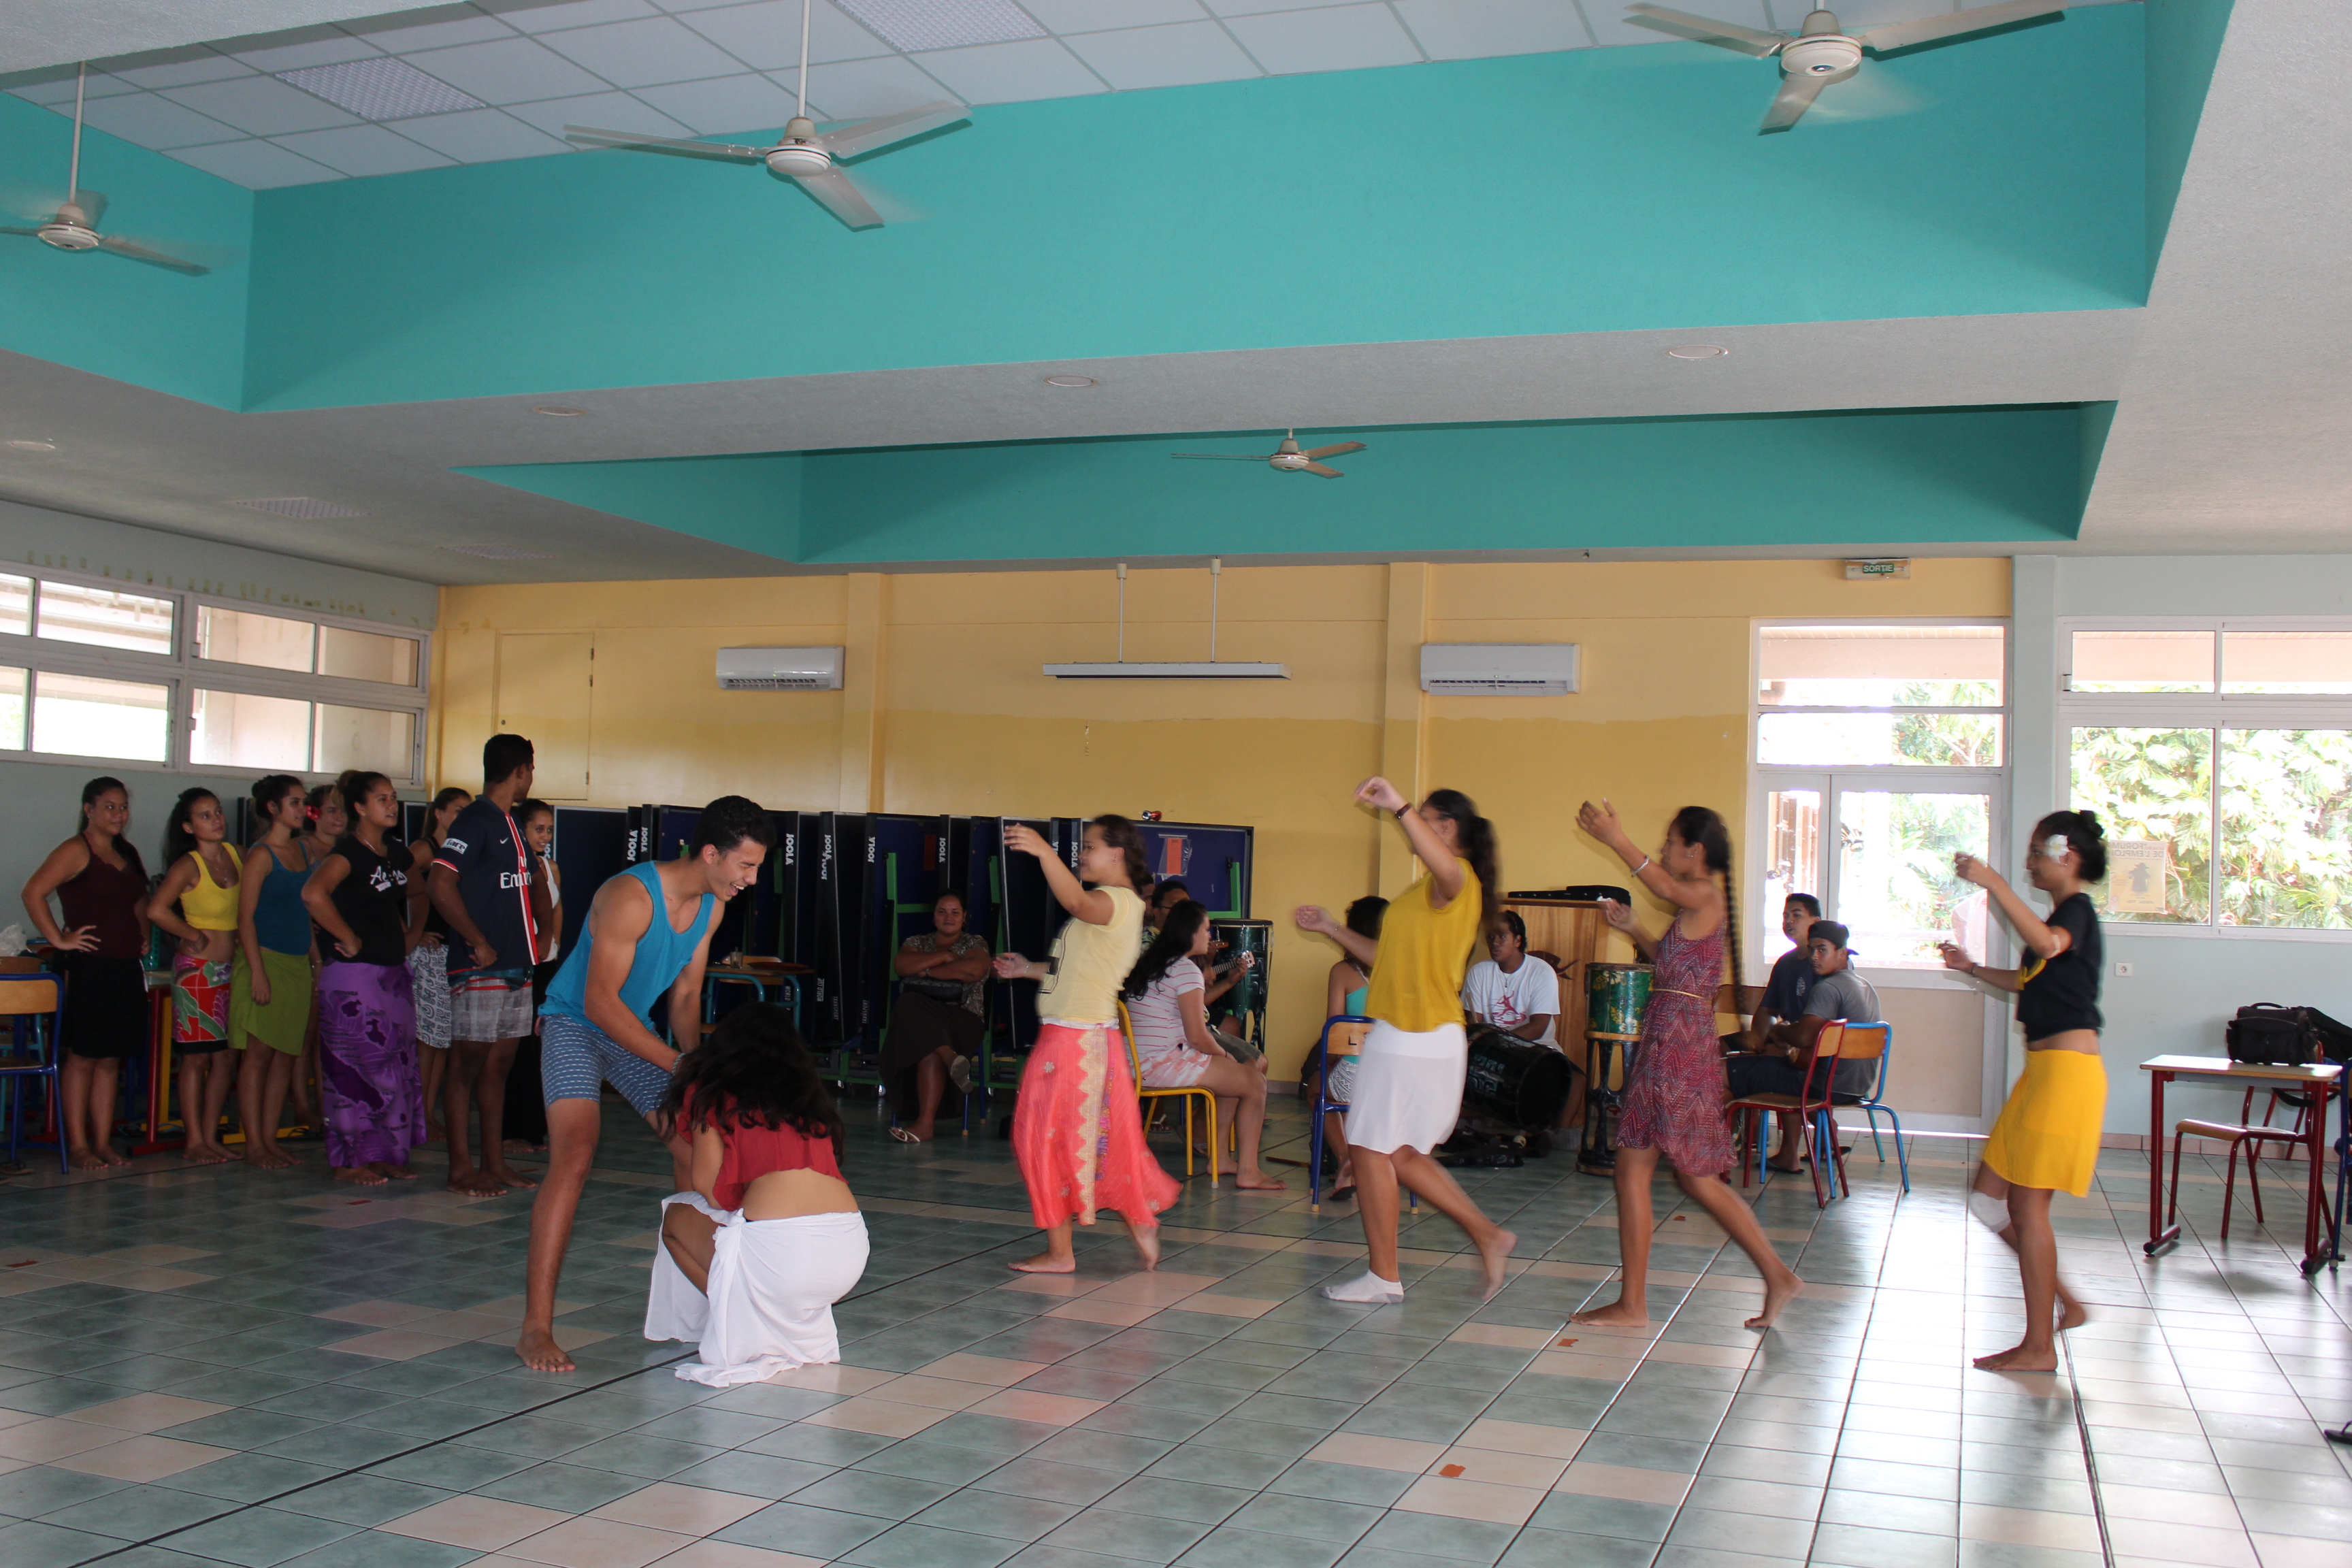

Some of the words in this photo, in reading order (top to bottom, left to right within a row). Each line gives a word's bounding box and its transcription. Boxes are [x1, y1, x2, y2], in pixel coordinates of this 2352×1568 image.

[1863, 565, 1893, 573] SORTIE
[627, 830, 638, 862] JOOLA
[785, 833, 795, 866] JOOLA
[824, 834, 832, 860] JOOLA
[938, 837, 947, 864] JOOLA
